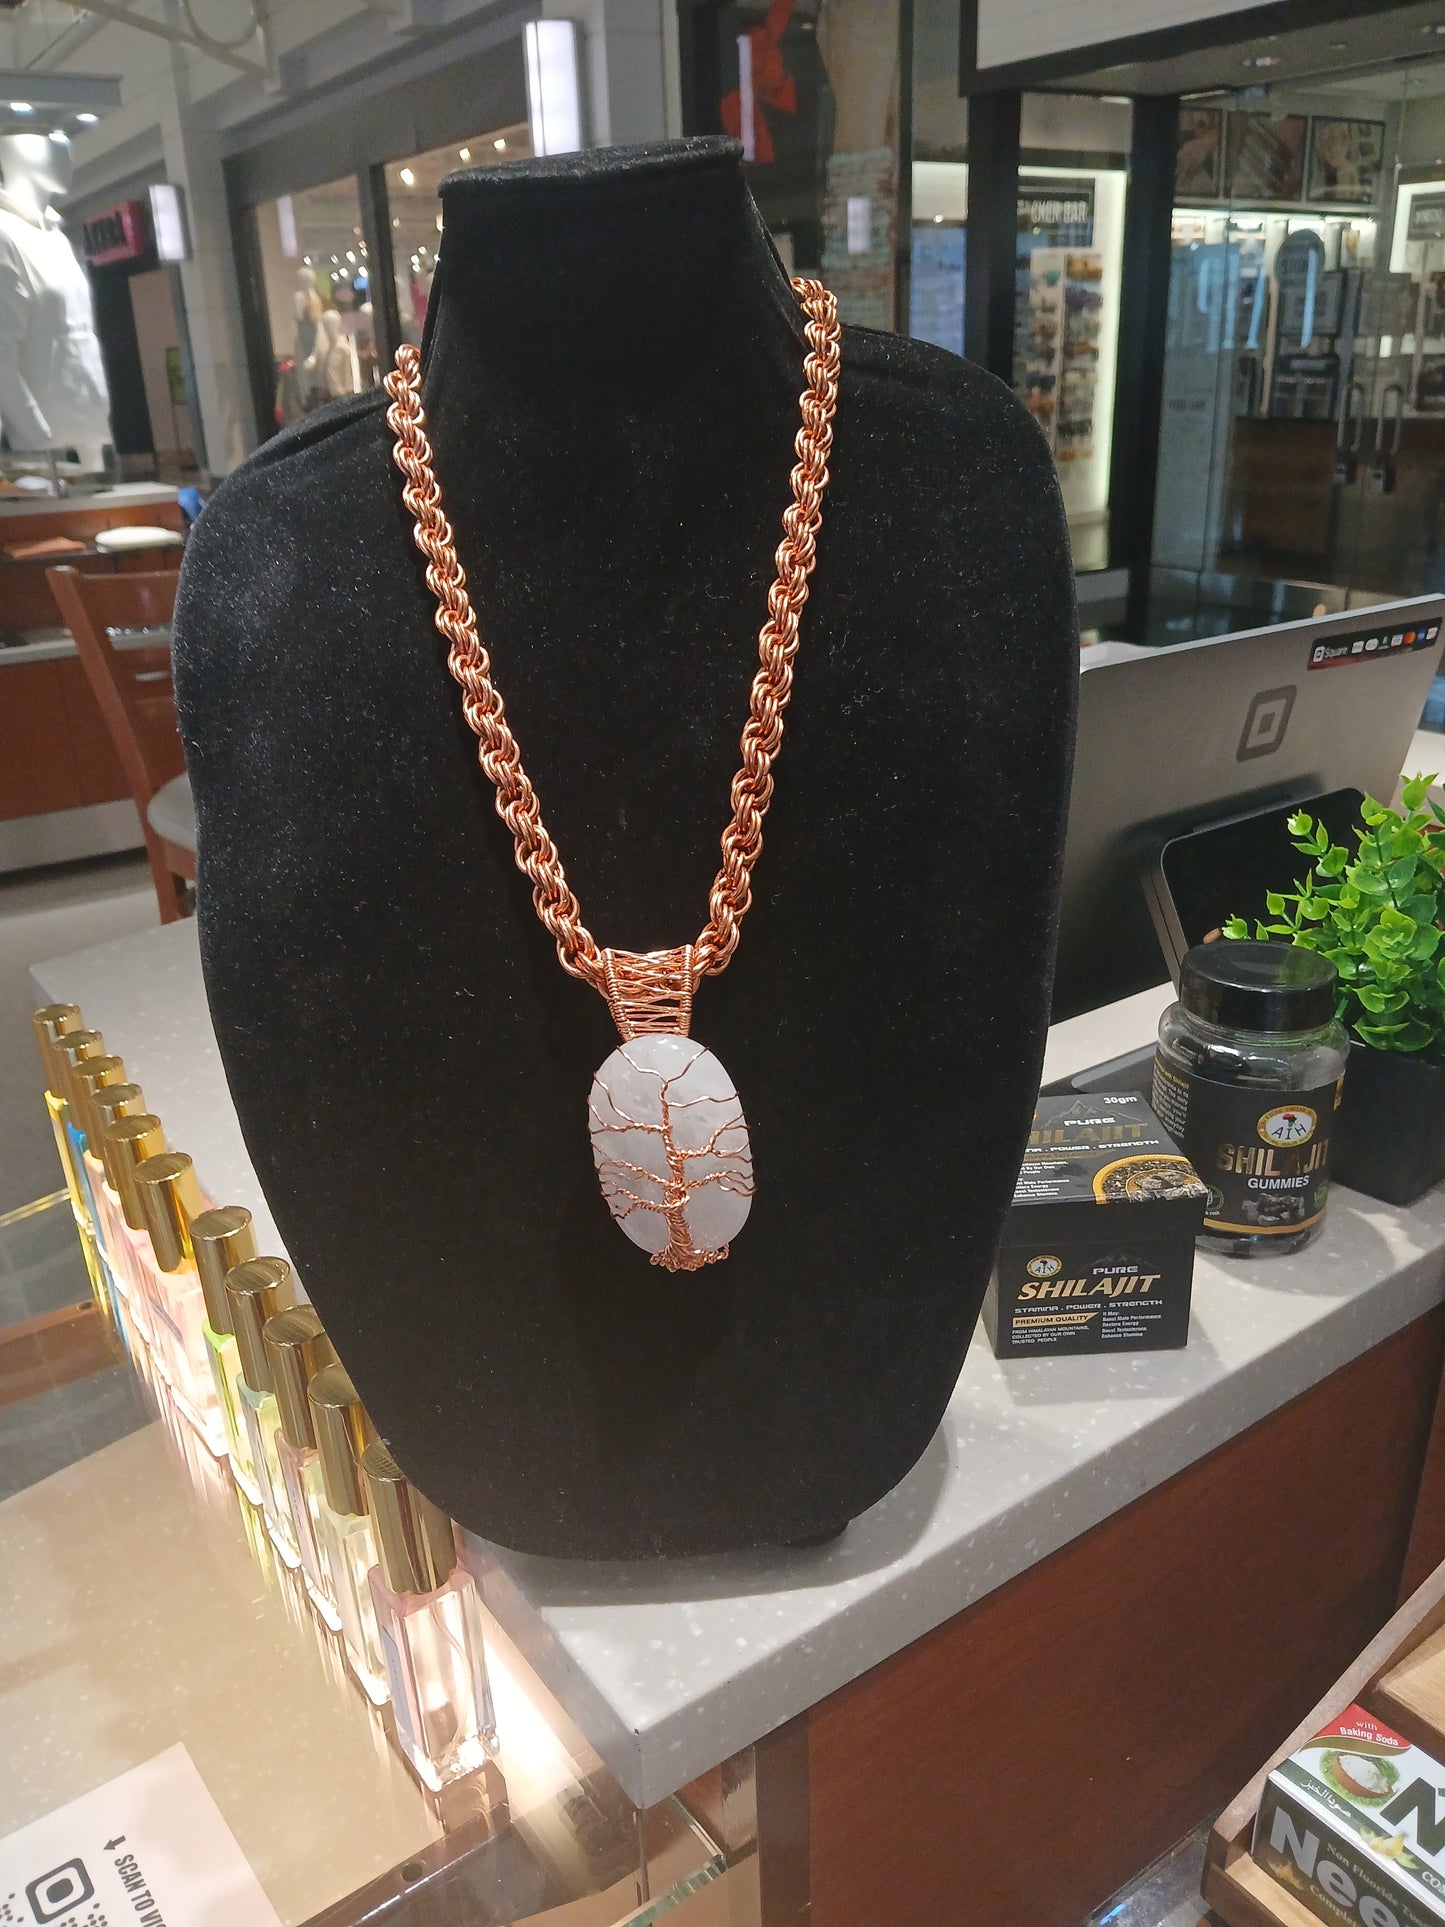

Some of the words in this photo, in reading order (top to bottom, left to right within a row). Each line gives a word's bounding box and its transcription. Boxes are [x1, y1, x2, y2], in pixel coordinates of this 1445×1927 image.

[1064, 201, 1088, 223] BAR
[1324, 645, 1348, 659] Square
[1103, 1096, 1138, 1105] 30gm
[1064, 1117, 1116, 1126] PURE
[1271, 1123, 1307, 1140] AIH
[1098, 1140, 1160, 1149] STRENGTH
[1247, 1175, 1310, 1189] GUMMIES
[1093, 1265, 1139, 1275] PURE
[1017, 1274, 1161, 1300] SHILAJIT
[1015, 1306, 1059, 1314] STAMINA
[1066, 1303, 1101, 1311] POWER
[1109, 1300, 1163, 1308] STRENGTH
[1015, 1317, 1054, 1325] PREMIUM
[1055, 1315, 1089, 1323] QUALITY
[1356, 1721, 1378, 1731] with
[1339, 1727, 1373, 1741] Baking
[1375, 1734, 1399, 1747] Soda
[1327, 1842, 1350, 1867] Non
[1353, 1864, 1399, 1906] Fluoride
[114, 1854, 147, 1893] SCAN
[131, 1889, 155, 1911] TO
